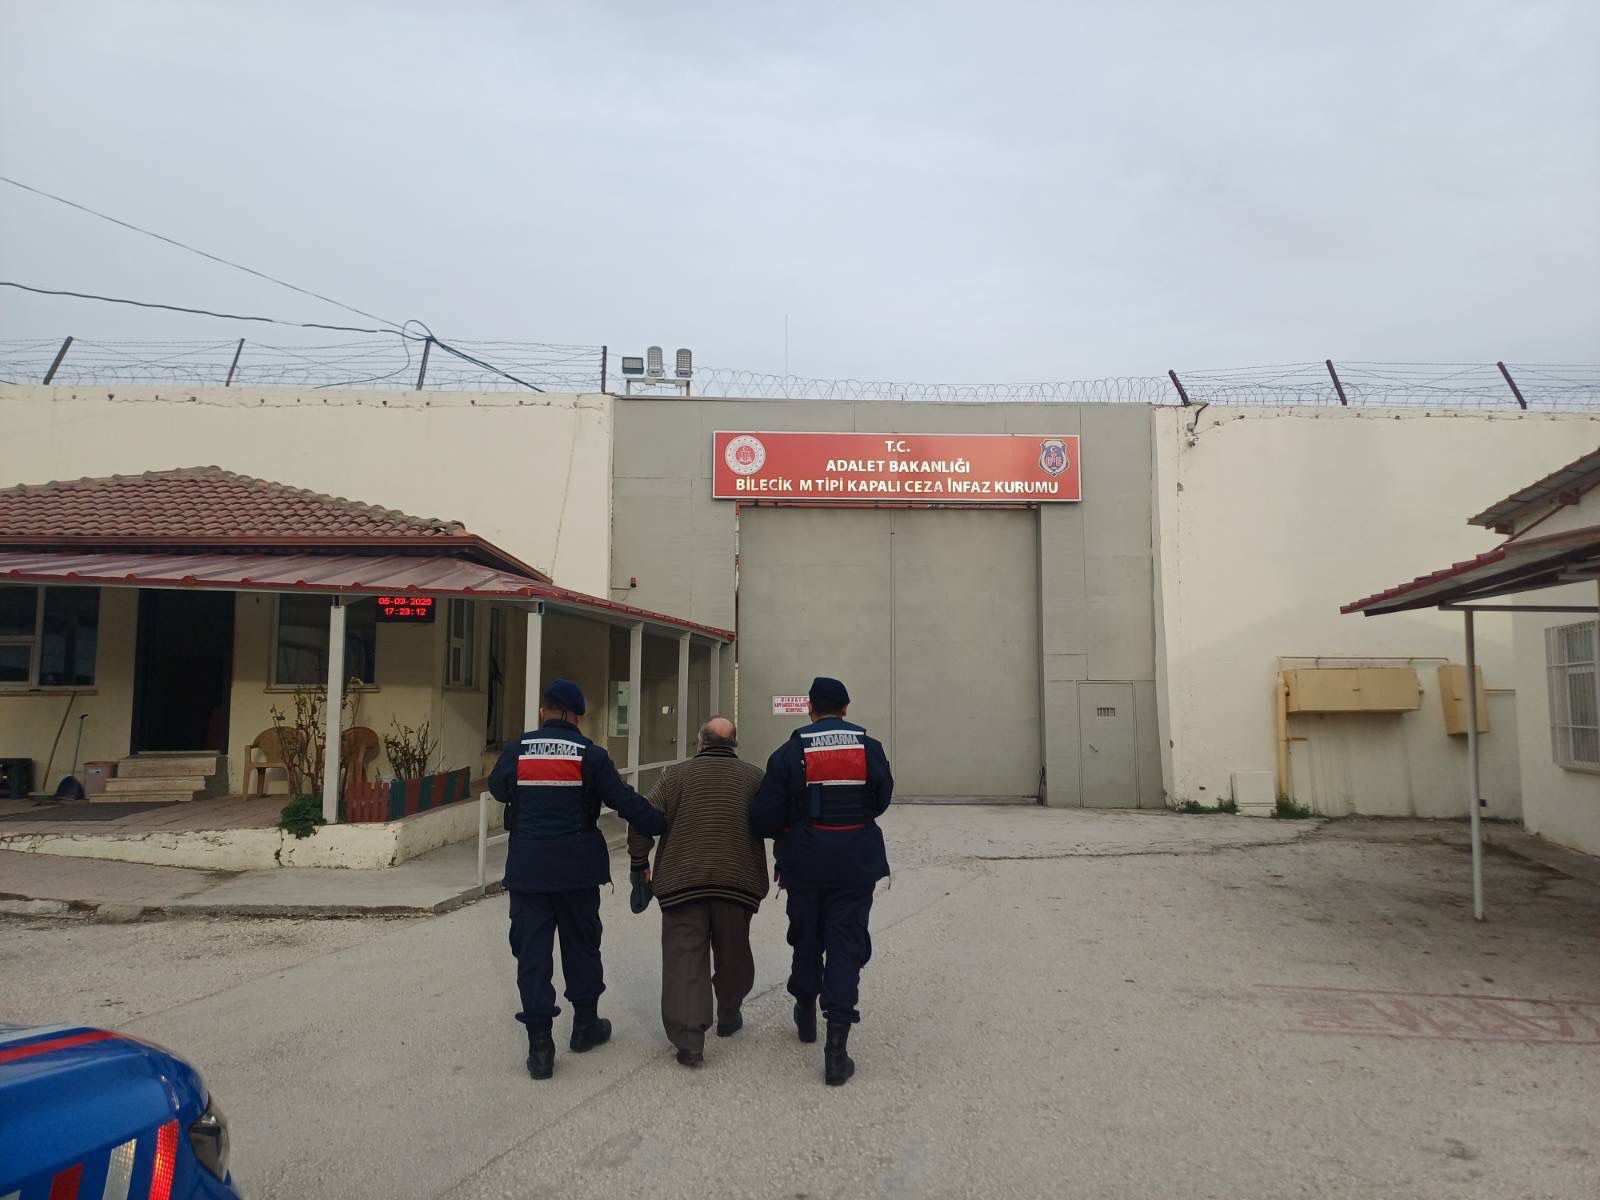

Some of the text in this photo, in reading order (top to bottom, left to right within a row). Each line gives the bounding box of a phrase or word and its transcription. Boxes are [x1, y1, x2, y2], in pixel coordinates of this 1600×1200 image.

[885, 440, 911, 452] T.C.
[826, 457, 970, 473] ADALET BAKANLIĞI
[736, 476, 1059, 493] BİLECİK M TİPİ KAPALI CEZA İNFAZ KURUMU
[811, 734, 860, 747] JANDARMA
[525, 743, 578, 756] JANDARMA
